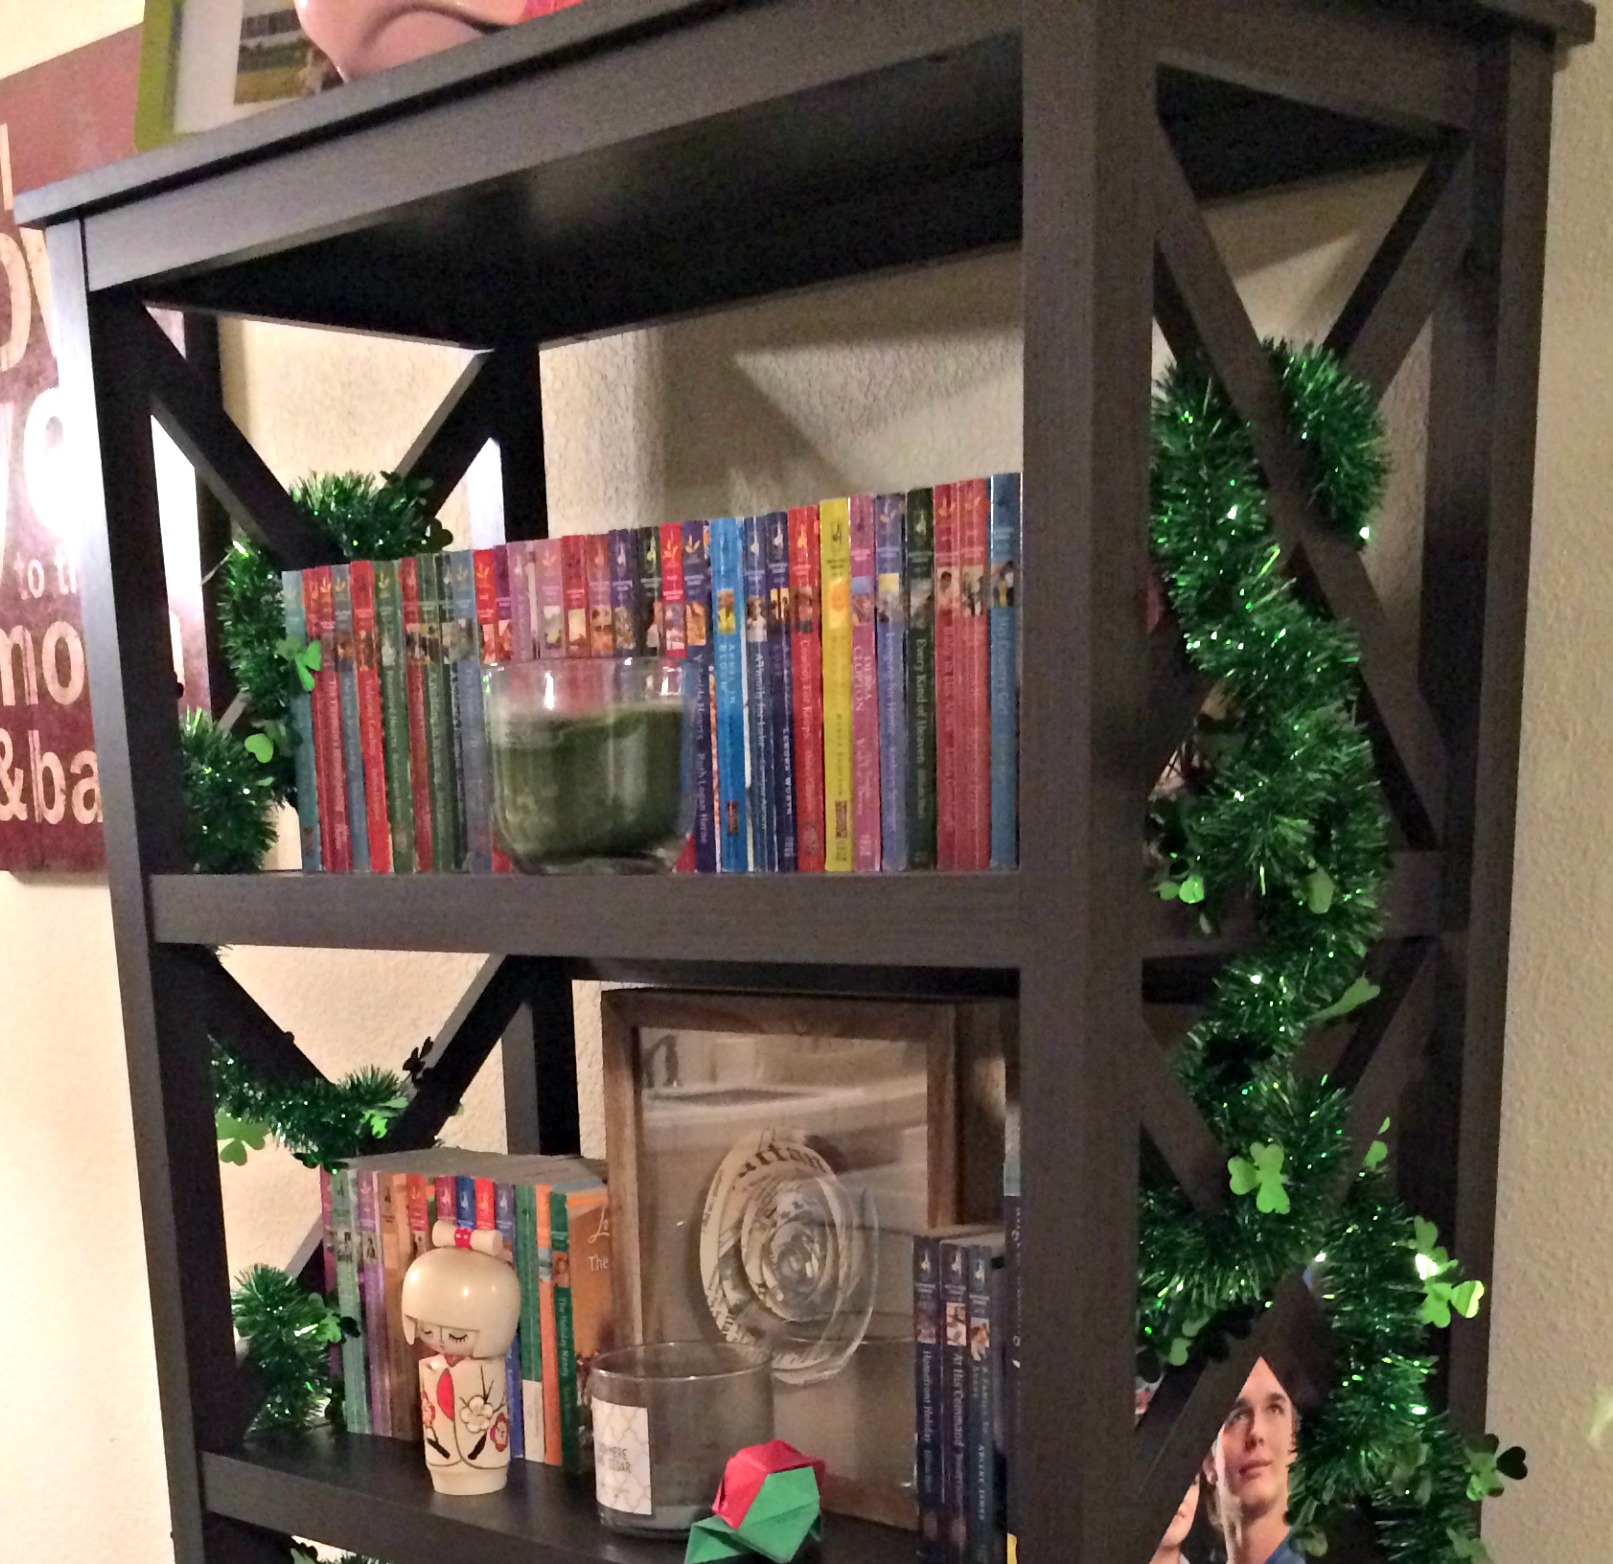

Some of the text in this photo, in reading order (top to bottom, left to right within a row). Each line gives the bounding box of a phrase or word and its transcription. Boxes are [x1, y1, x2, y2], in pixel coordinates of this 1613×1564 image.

[14, 551, 45, 601] to
[914, 639, 927, 672] Every
[854, 646, 866, 711] CLOPTON
[916, 674, 928, 703] Kind
[916, 704, 927, 718] of
[916, 720, 927, 764] Heaven
[785, 777, 793, 815] WORTH
[588, 1255, 609, 1271] The
[558, 1297, 568, 1315] The
[922, 1350, 932, 1403] Homefront
[953, 1352, 963, 1366] At
[953, 1368, 964, 1387] His
[922, 1405, 934, 1444] Holiday
[953, 1389, 966, 1447] Command
